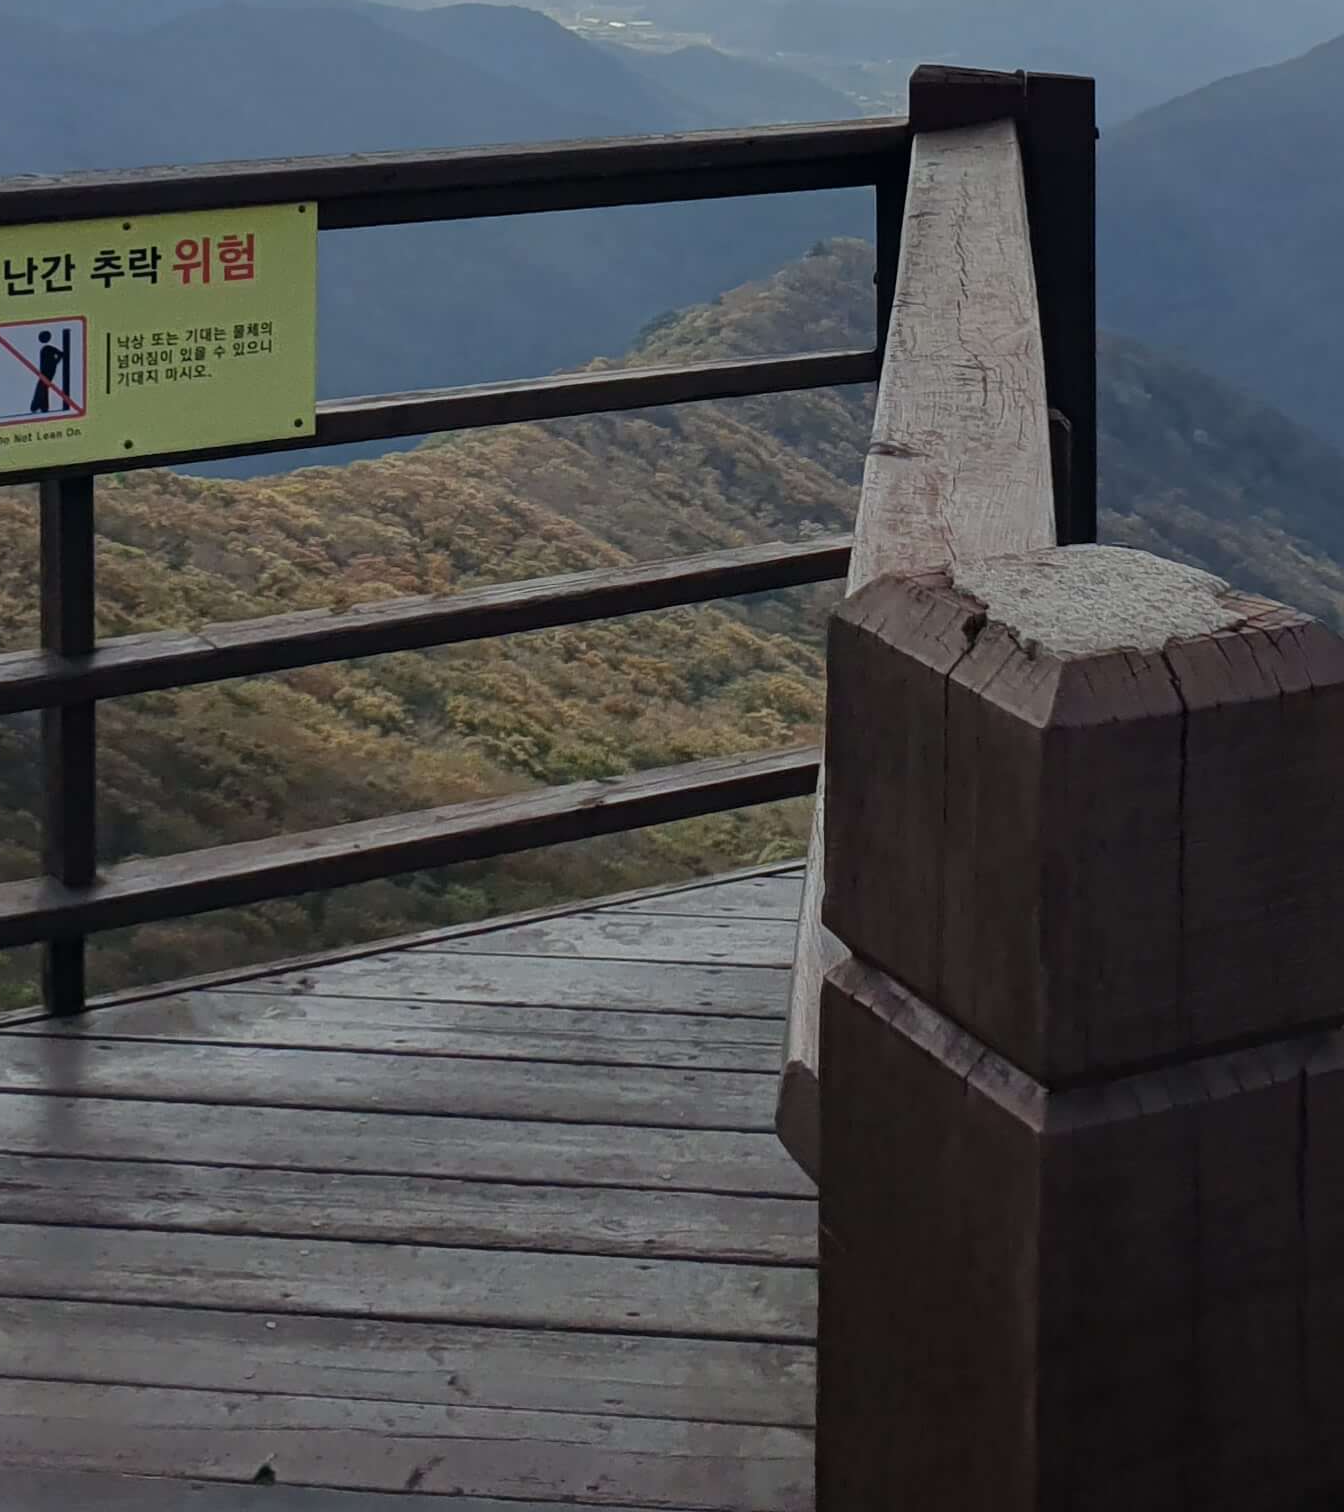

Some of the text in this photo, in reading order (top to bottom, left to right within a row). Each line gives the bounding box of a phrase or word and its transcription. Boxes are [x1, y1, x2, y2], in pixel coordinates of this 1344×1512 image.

[3, 232, 256, 297] 난간 추락 위험
[151, 331, 180, 346] 또는
[185, 326, 227, 344] 기대는
[233, 320, 273, 340] 물체의
[117, 338, 273, 369] 넘어짐이 있을 수 있으니
[117, 363, 213, 387] 기대지 마시오.
[36, 431, 63, 442] Lean
